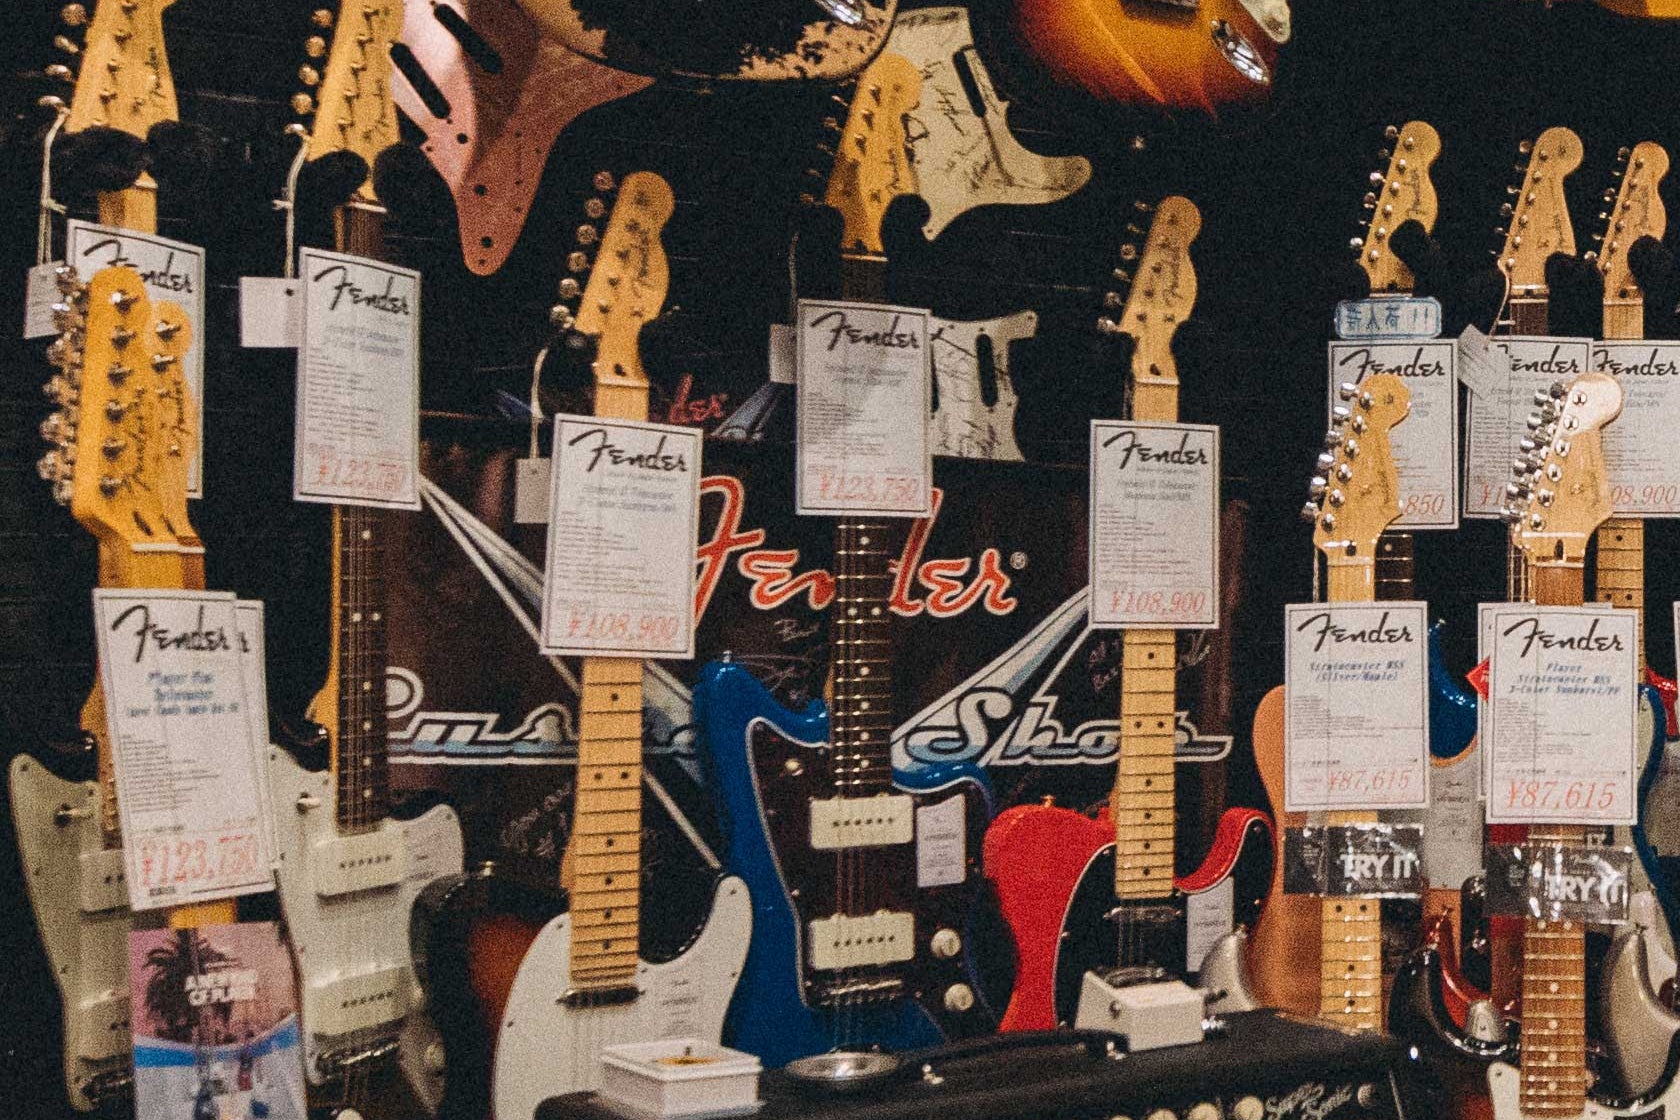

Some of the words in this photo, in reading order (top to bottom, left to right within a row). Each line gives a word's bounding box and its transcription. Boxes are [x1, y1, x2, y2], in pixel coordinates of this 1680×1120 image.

[314, 265, 410, 315] Fender
[810, 310, 920, 351] Fender
[569, 430, 689, 473] Fender
[1103, 431, 1209, 469] Fender
[112, 602, 230, 664] Fender
[1297, 612, 1414, 652] Fender
[1504, 618, 1624, 659] Fender
[1328, 769, 1413, 793] ¥87,615
[1507, 781, 1617, 812] ¥87,615
[1341, 851, 1389, 881] TRY
[1392, 851, 1417, 880] IT
